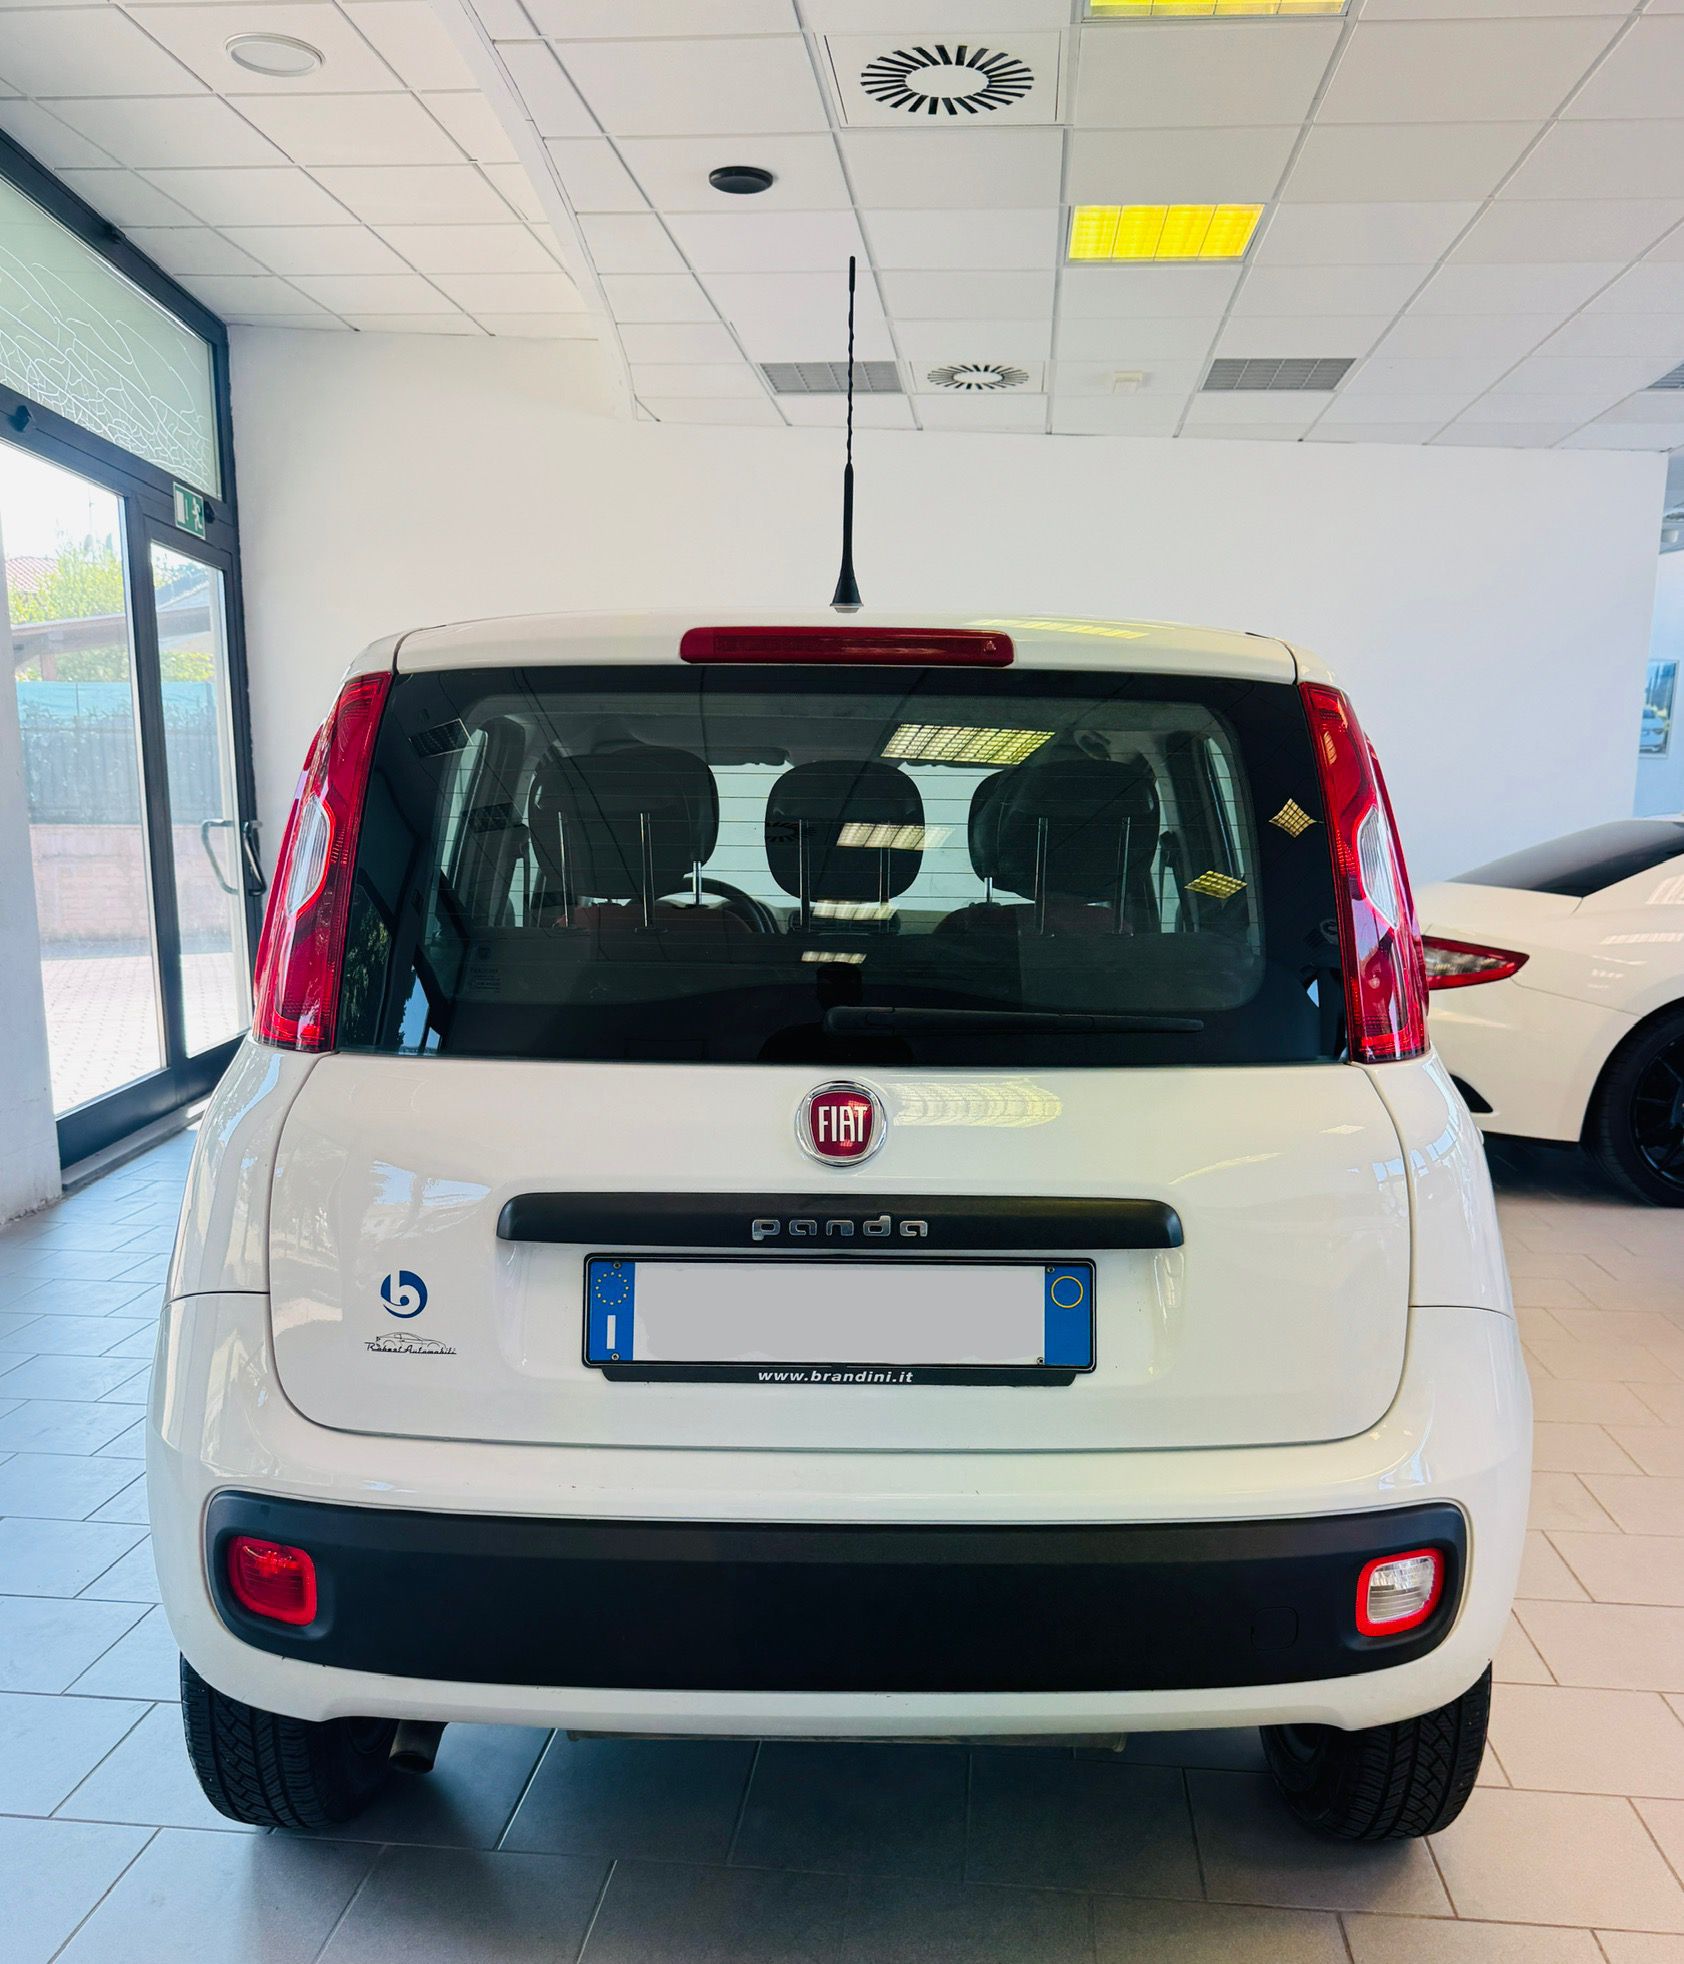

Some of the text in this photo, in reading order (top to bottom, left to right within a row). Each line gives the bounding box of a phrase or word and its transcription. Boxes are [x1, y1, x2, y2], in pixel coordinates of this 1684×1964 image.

[818, 1106, 867, 1142] FIAT
[752, 1215, 928, 1240] panda
[606, 1315, 616, 1349] I
[404, 1344, 456, 1355] Automobili
[758, 1370, 913, 1383] www.brandini.it
